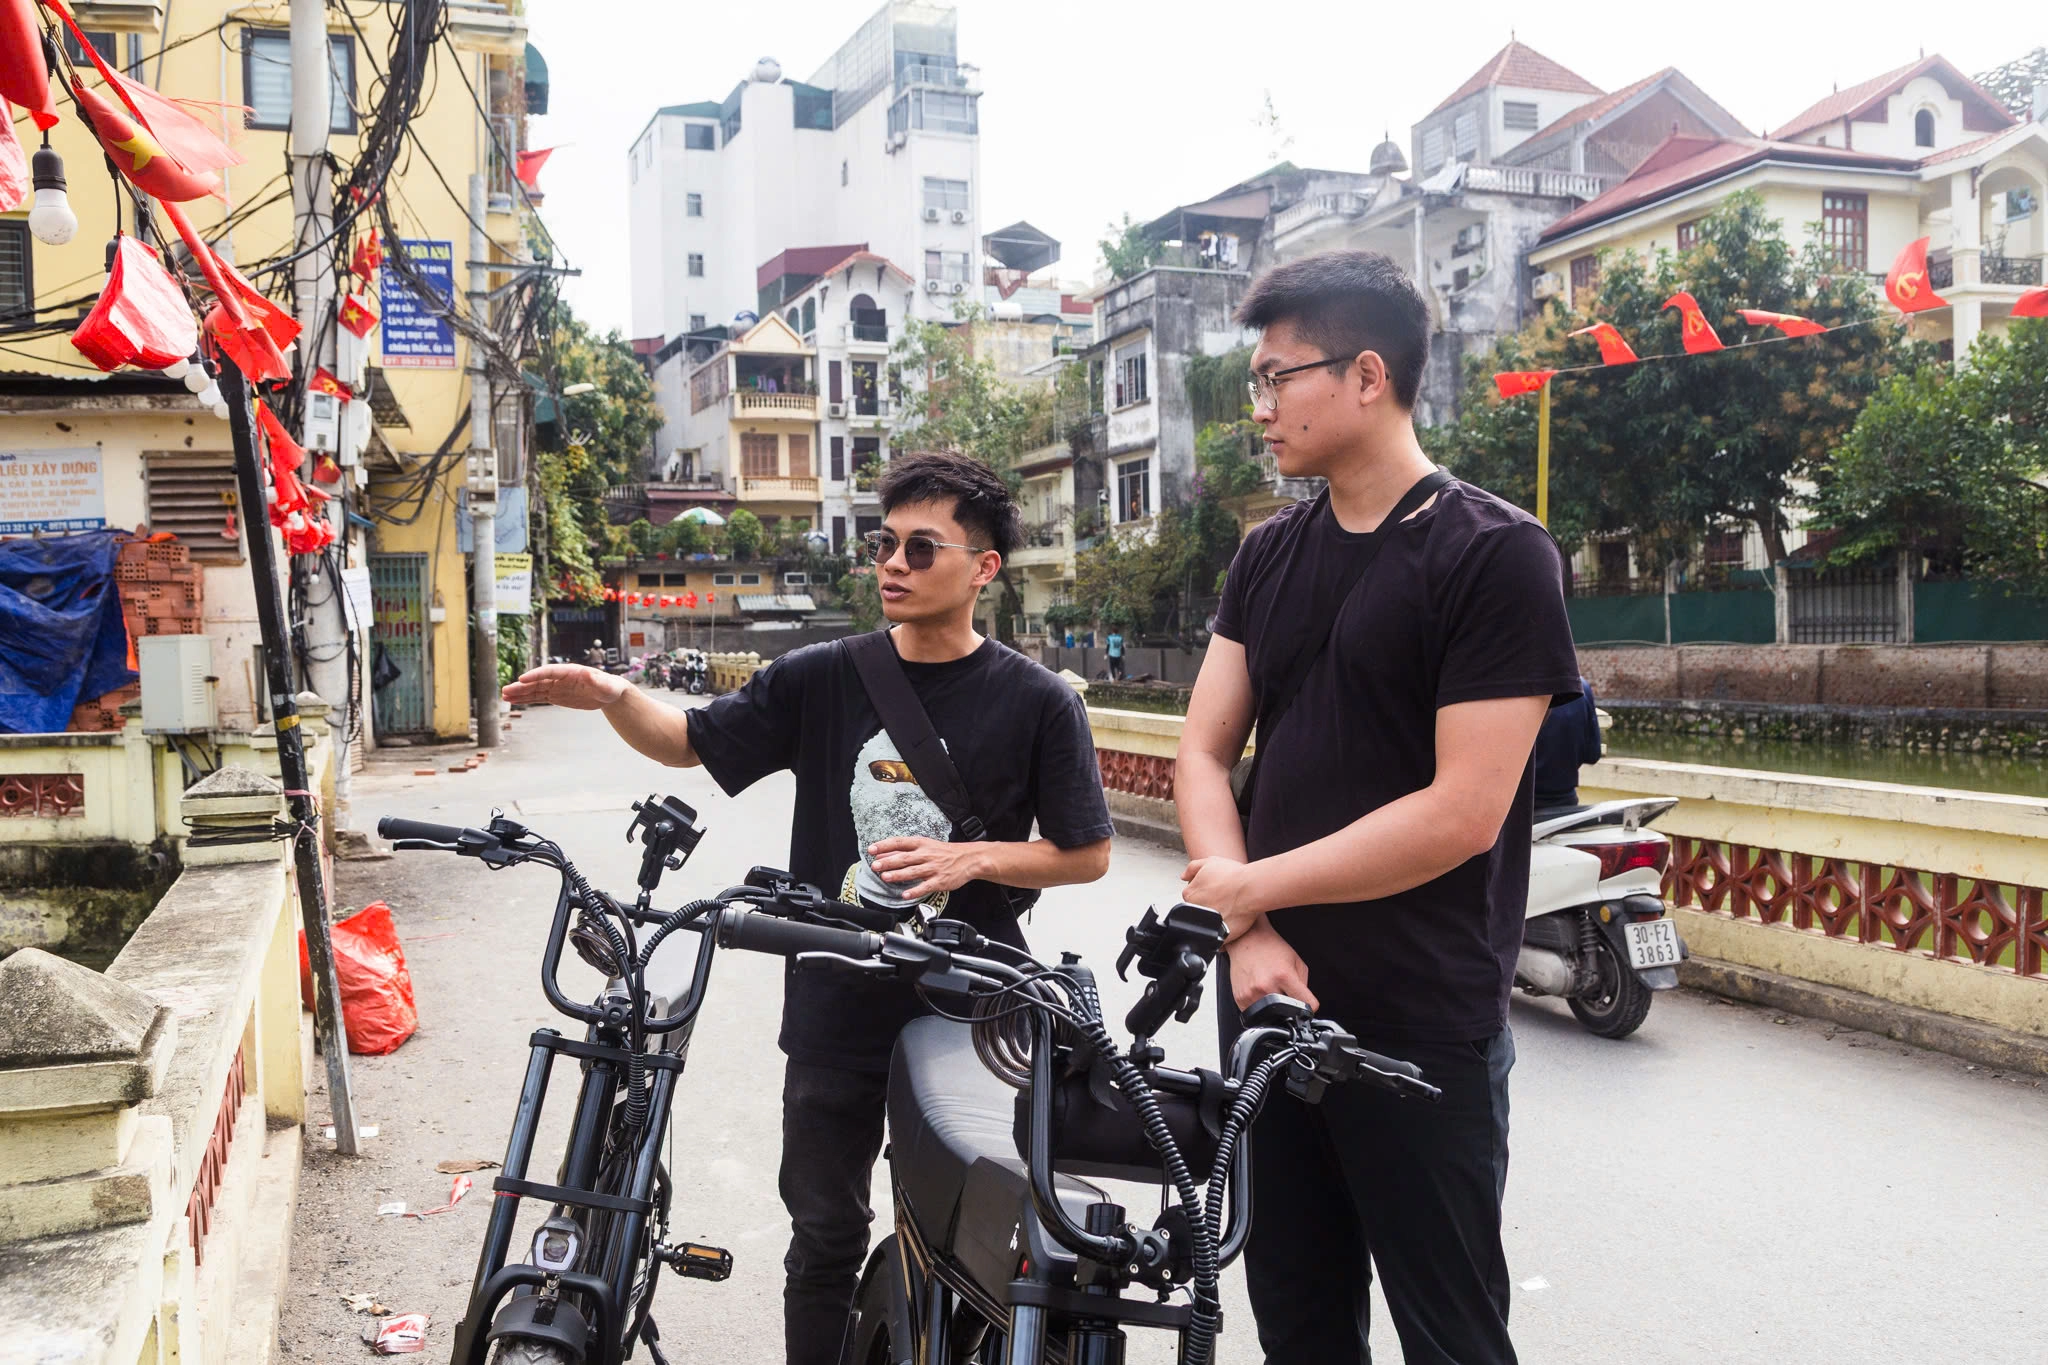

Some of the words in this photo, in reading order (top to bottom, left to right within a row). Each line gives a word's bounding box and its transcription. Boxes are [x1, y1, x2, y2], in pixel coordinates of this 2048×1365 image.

[32, 460, 57, 476] XÂY
[62, 461, 97, 476] DỰNG
[1637, 943, 1674, 965] 3863
